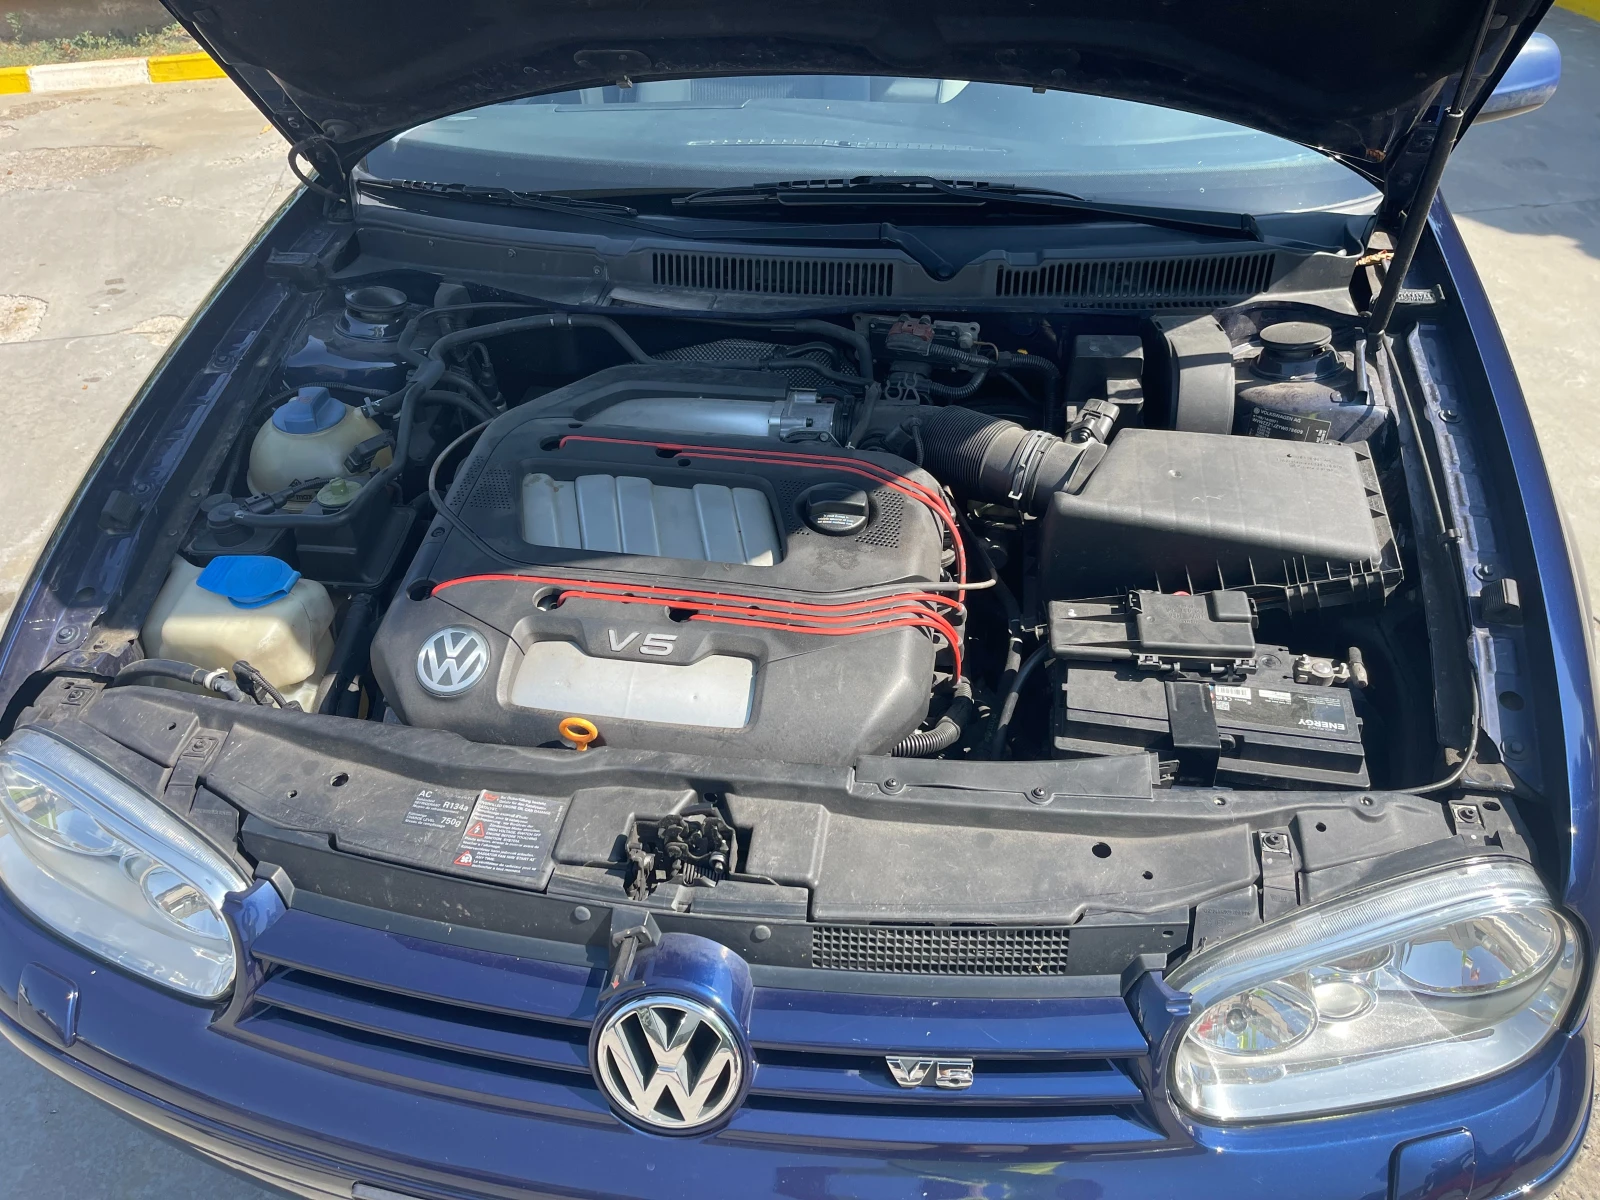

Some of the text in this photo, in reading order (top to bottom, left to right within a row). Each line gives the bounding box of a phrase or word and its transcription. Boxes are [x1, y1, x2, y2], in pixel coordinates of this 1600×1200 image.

[1261, 409, 1293, 421] VOLKSWAGEN
[607, 628, 678, 657] V5
[417, 628, 491, 695] VW
[1298, 718, 1346, 731] ENERGY
[418, 790, 433, 798] AC
[442, 801, 469, 812] R134a
[440, 816, 462, 828] 750g
[597, 996, 743, 1129] VW
[885, 1055, 974, 1090] V5
